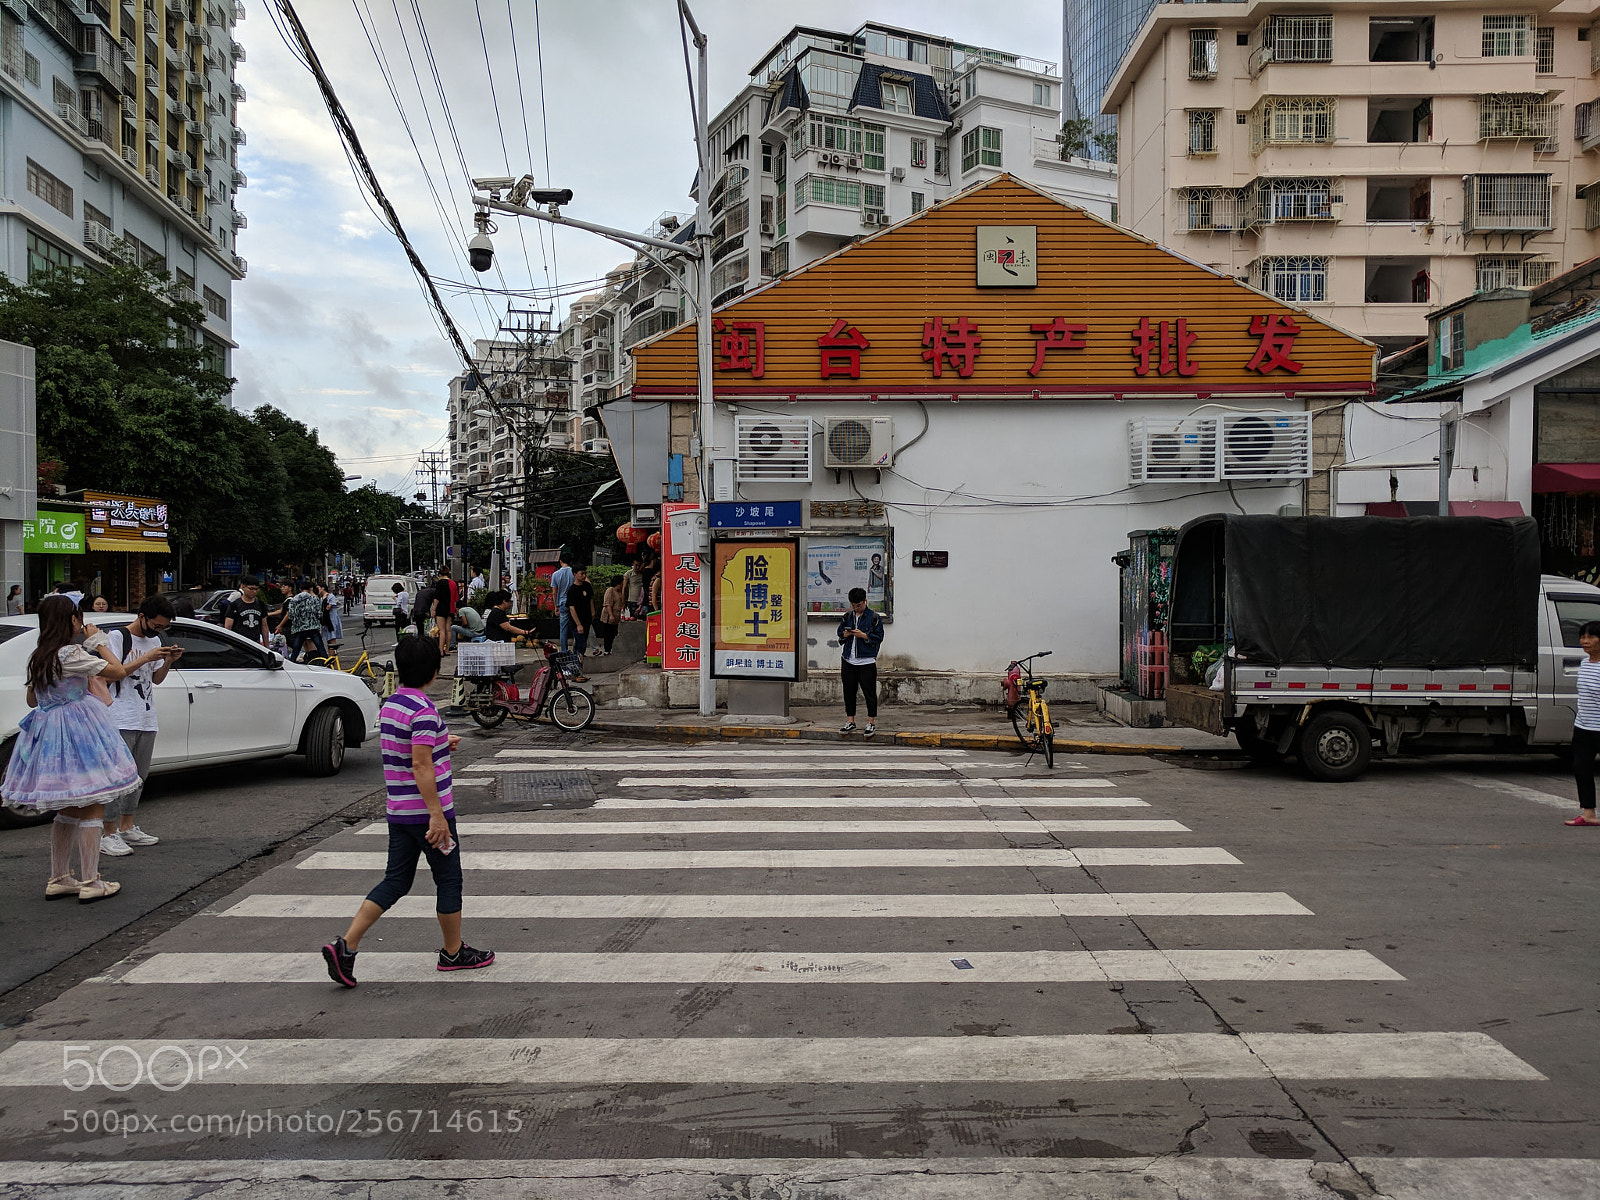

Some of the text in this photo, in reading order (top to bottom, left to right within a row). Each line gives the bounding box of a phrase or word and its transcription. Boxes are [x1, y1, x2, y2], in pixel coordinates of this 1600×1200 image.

[713, 314, 1304, 379] 闽台特产批发
[735, 506, 775, 518] 沙坡尾
[744, 554, 769, 637] 脸博士
[770, 594, 783, 622] 整形
[725, 658, 784, 669] 明星脸 博士造
